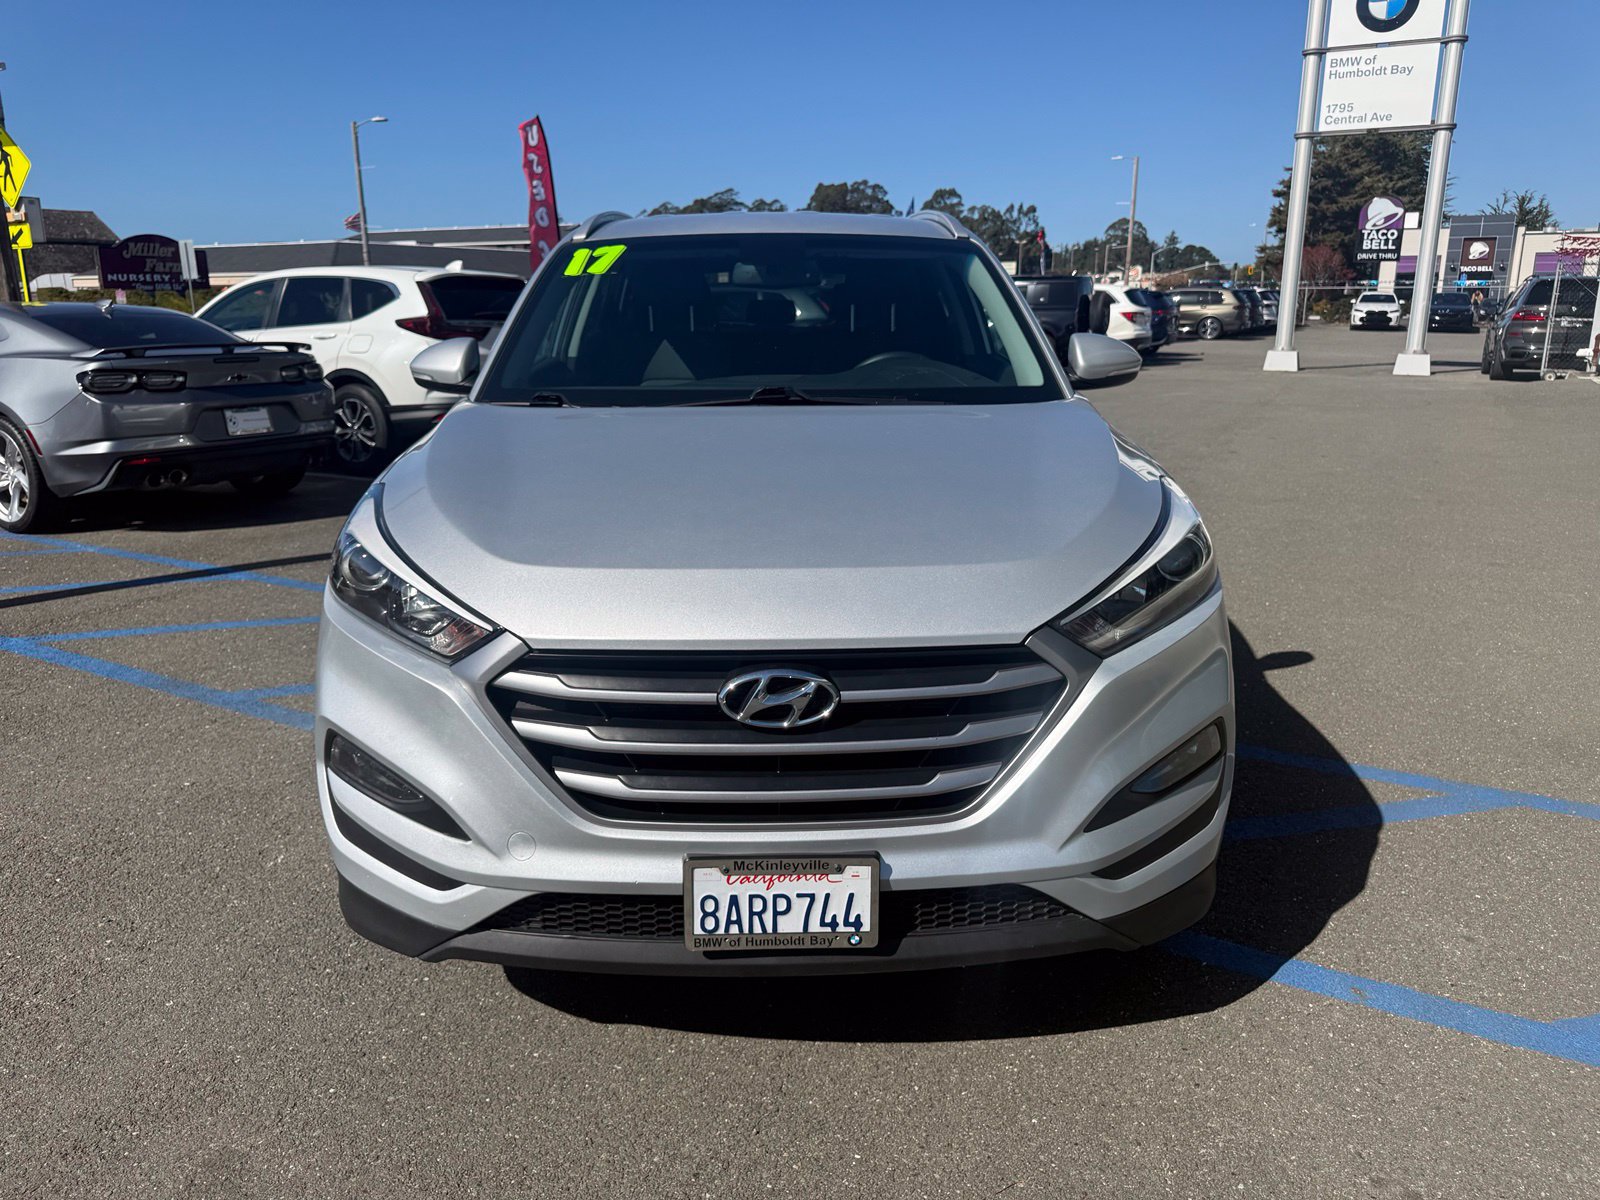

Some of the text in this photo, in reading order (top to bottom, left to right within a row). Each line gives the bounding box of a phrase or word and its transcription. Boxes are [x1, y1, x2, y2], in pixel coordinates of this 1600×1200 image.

[1330, 54, 1377, 68] BMW of
[1329, 64, 1414, 80] Humboldt Bay
[1326, 102, 1354, 114] 1795
[1324, 112, 1393, 126] Central Ave
[1361, 229, 1398, 240] TACO
[122, 242, 175, 259] Miller
[1362, 239, 1396, 250] BELL
[564, 244, 627, 276] 17
[1357, 252, 1398, 261] DRIVE THRU
[733, 860, 830, 873] McKinleyville
[699, 892, 864, 934] 8ARP744
[694, 934, 834, 948] BMW of Humboldt Bay
